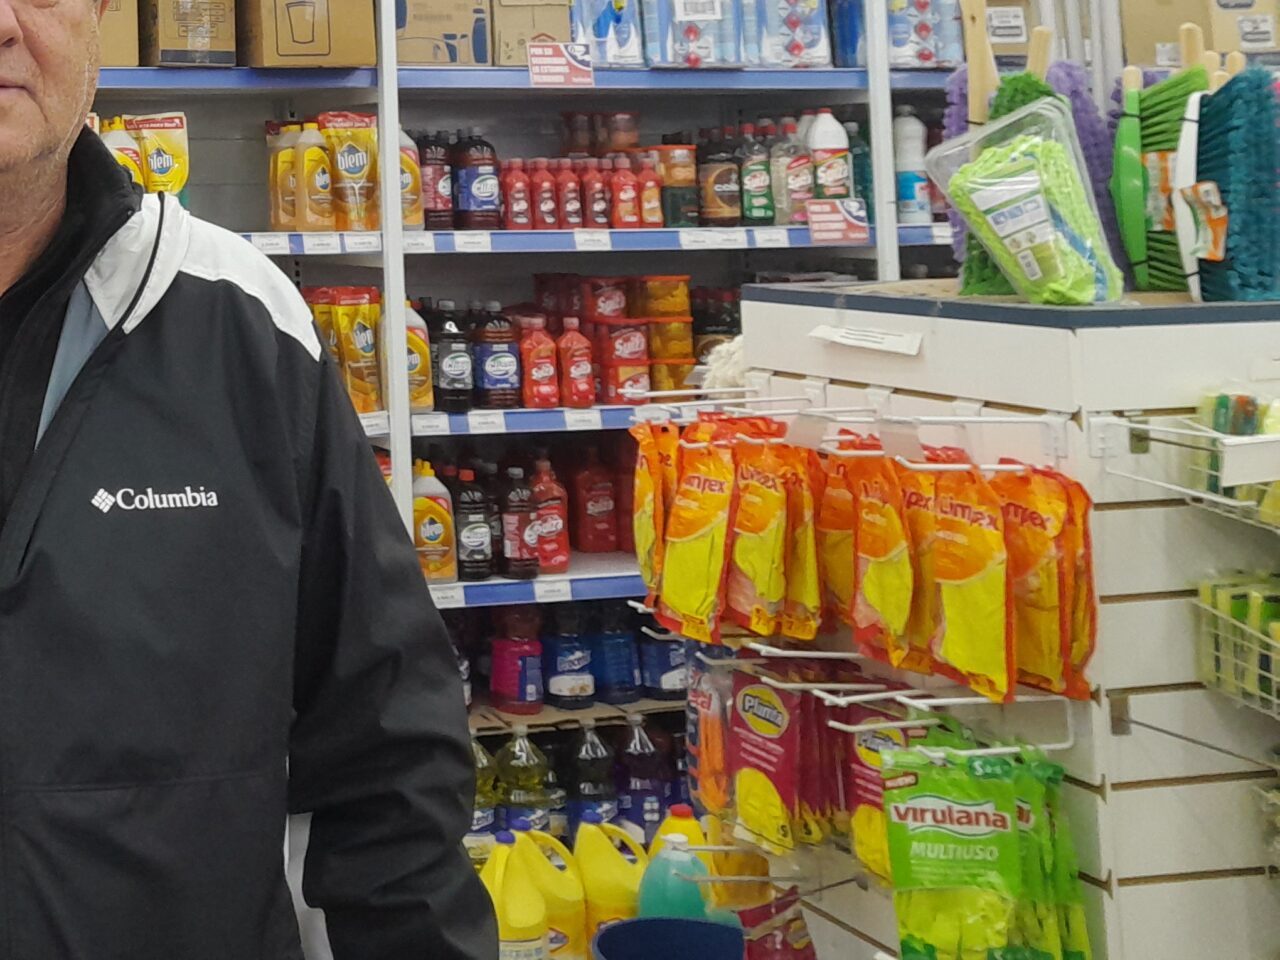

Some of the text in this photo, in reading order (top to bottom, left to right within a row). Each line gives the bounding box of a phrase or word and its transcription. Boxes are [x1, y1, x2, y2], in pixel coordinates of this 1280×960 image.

[337, 150, 368, 171] blem
[116, 486, 219, 510] Columbia
[893, 803, 1009, 830] virulana
[910, 841, 999, 861] MULTIUSO
